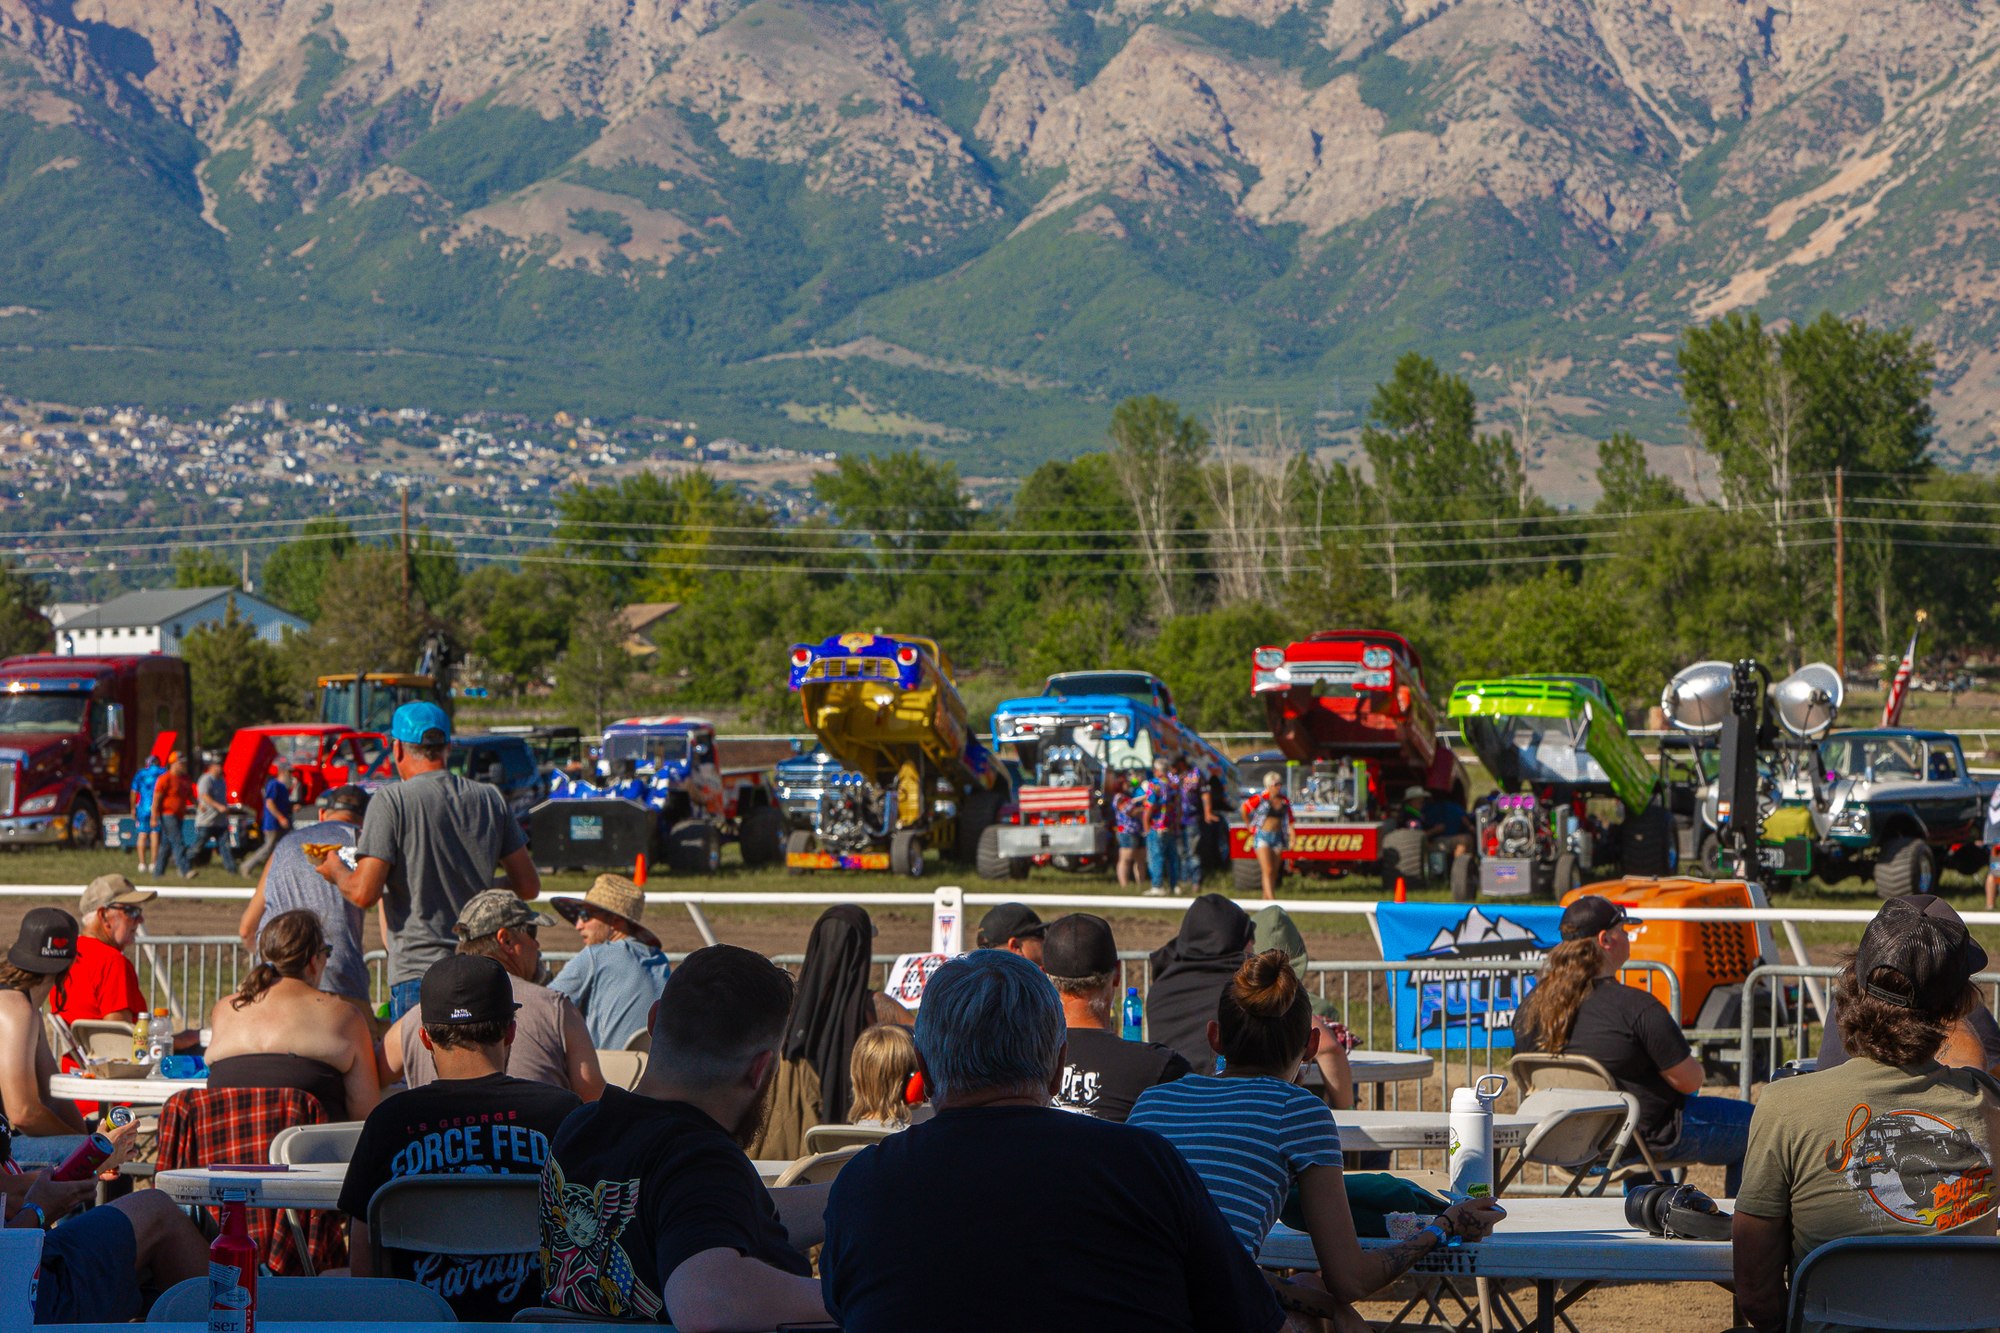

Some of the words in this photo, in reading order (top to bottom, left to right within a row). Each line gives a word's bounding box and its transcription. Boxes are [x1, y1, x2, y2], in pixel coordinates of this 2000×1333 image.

[439, 1110, 517, 1129] GEORGE
[391, 1125, 484, 1180] FORCE
[492, 1124, 549, 1166] FED
